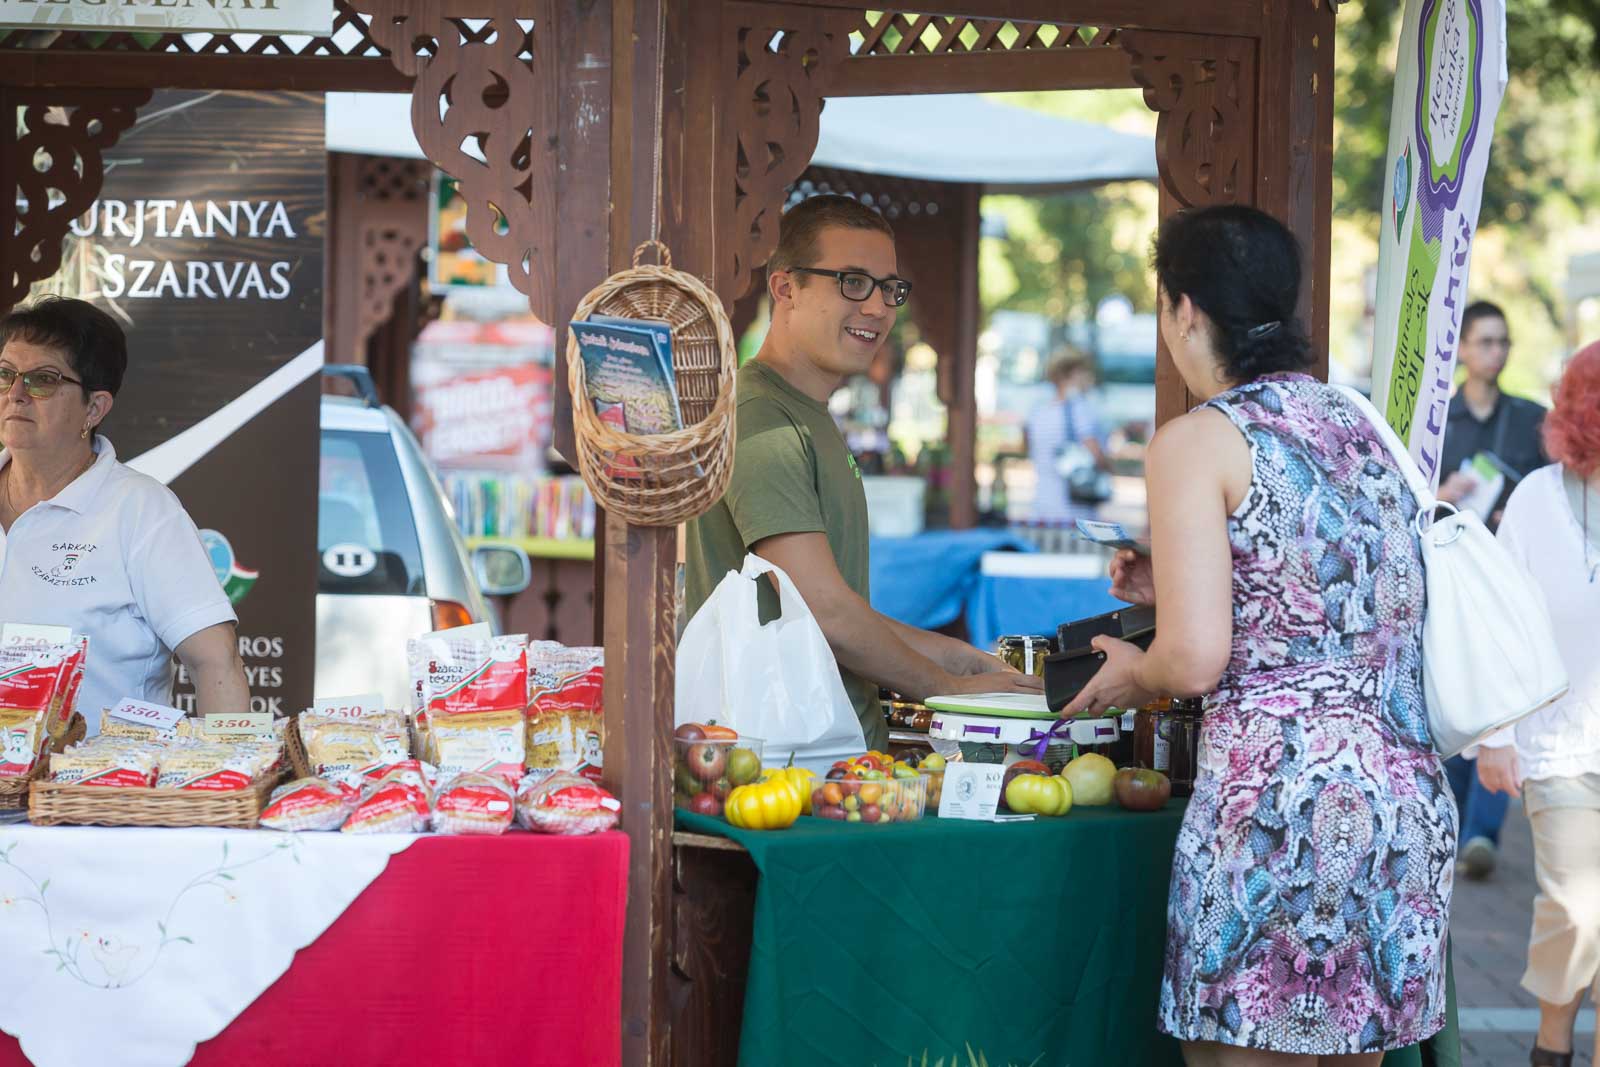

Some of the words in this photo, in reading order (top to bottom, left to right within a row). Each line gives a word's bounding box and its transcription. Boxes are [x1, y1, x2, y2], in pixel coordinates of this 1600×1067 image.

[1430, 0, 1456, 126] Herczeg
[1440, 27, 1460, 140] Aranka
[211, 719, 266, 728] 350.-
